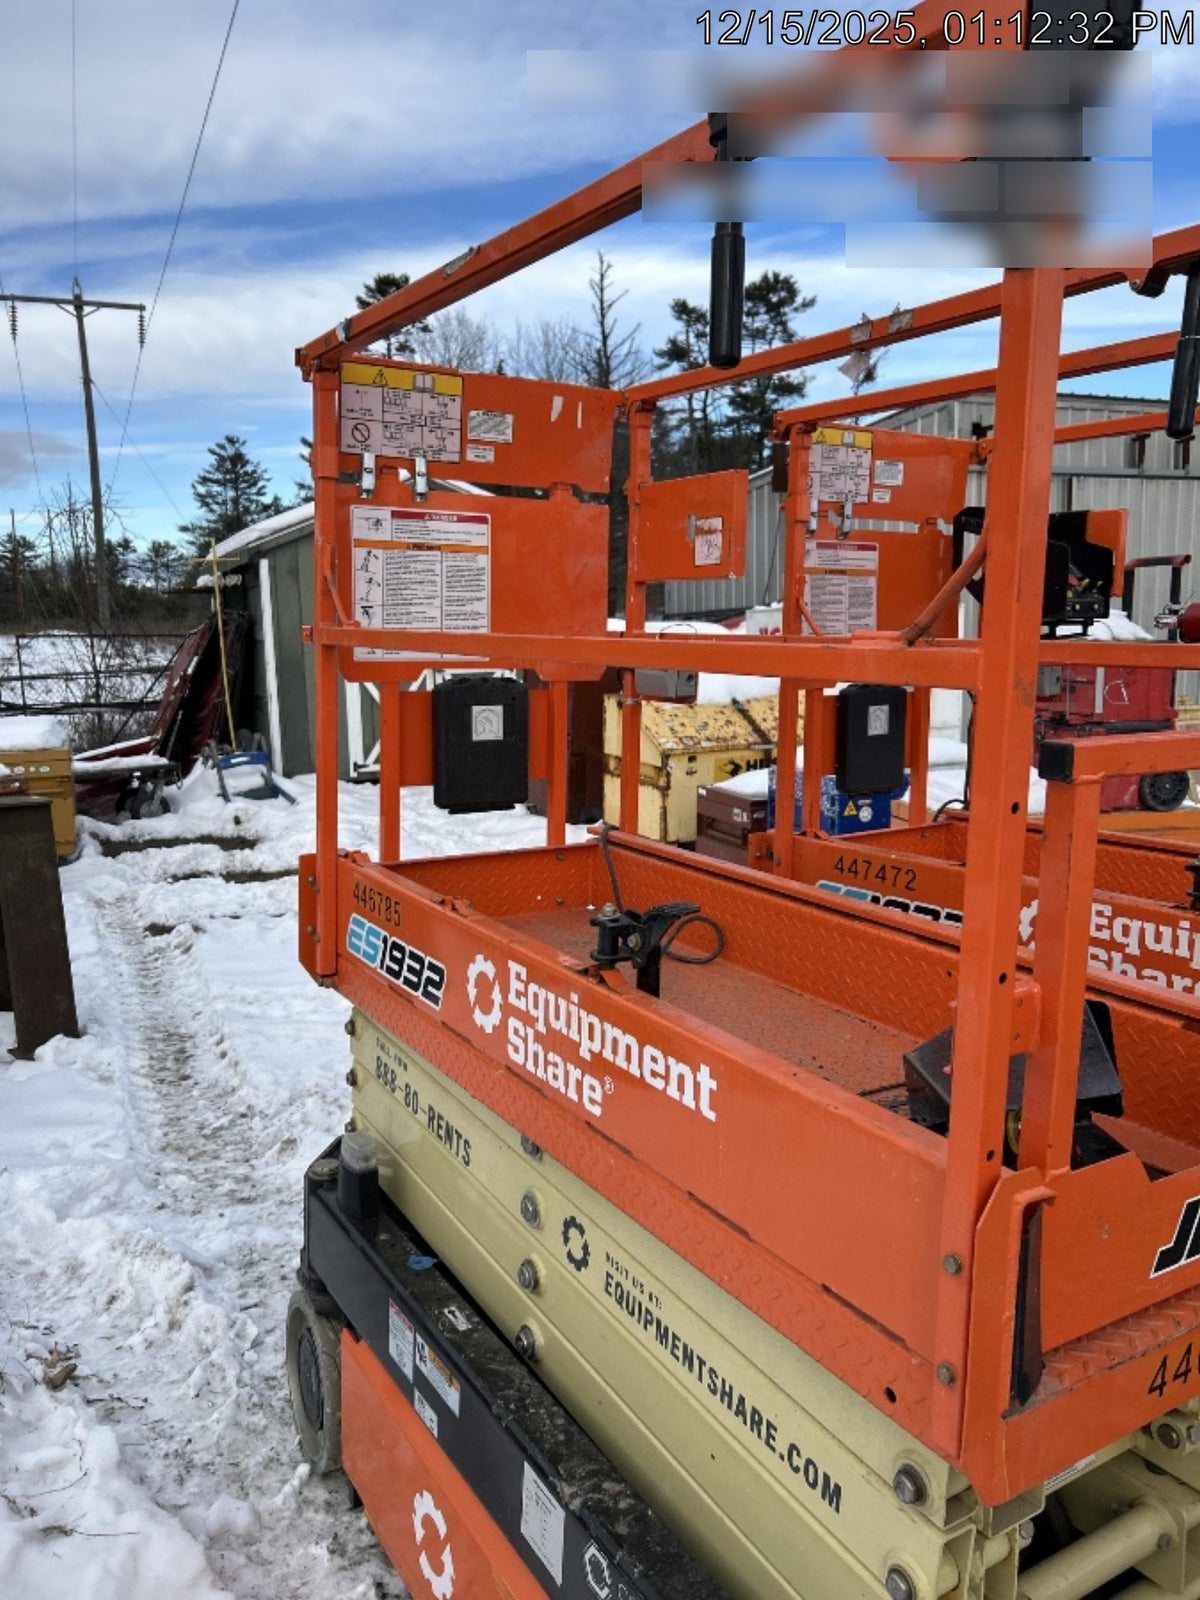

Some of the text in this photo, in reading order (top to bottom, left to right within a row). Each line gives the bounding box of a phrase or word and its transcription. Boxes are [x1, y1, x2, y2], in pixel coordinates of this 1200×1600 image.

[834, 855, 917, 891] 447472
[353, 881, 400, 927] 446785
[347, 912, 446, 1012] ES1932
[1087, 945, 1200, 997] Shar
[508, 959, 717, 1122] Equipment
[375, 1055, 472, 1167] 888-80-RENTS
[605, 1251, 629, 1281] VISIT
[632, 1275, 645, 1295] US
[604, 1270, 842, 1515] EQUIPMENTSHARE.COM
[1147, 1342, 1200, 1397] 44
